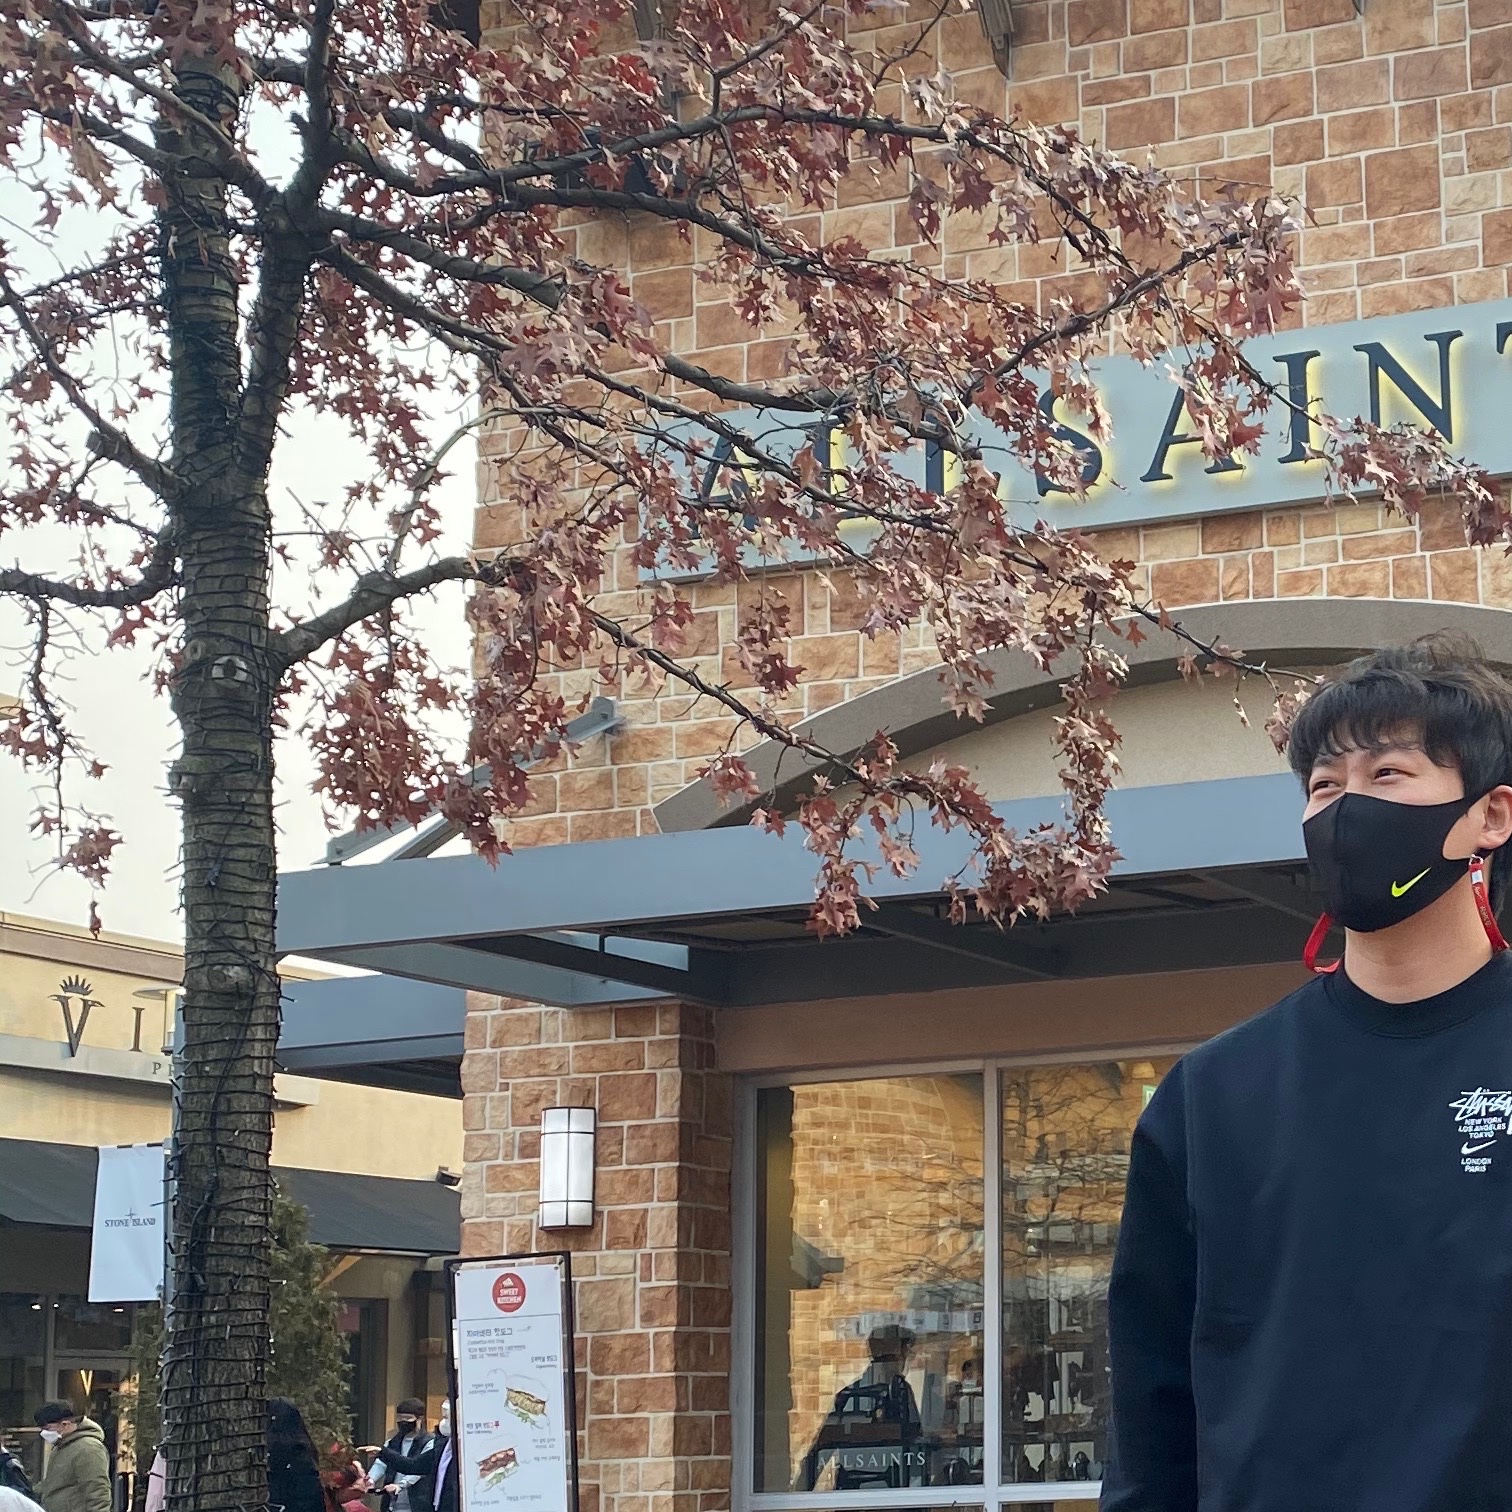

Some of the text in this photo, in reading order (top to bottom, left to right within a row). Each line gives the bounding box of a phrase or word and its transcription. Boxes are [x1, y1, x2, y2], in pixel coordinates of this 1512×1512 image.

[1474, 1123, 1506, 1132] ANGELES
[1469, 1131, 1494, 1139] TOKYO
[104, 1218, 156, 1227] STONE ISLAND
